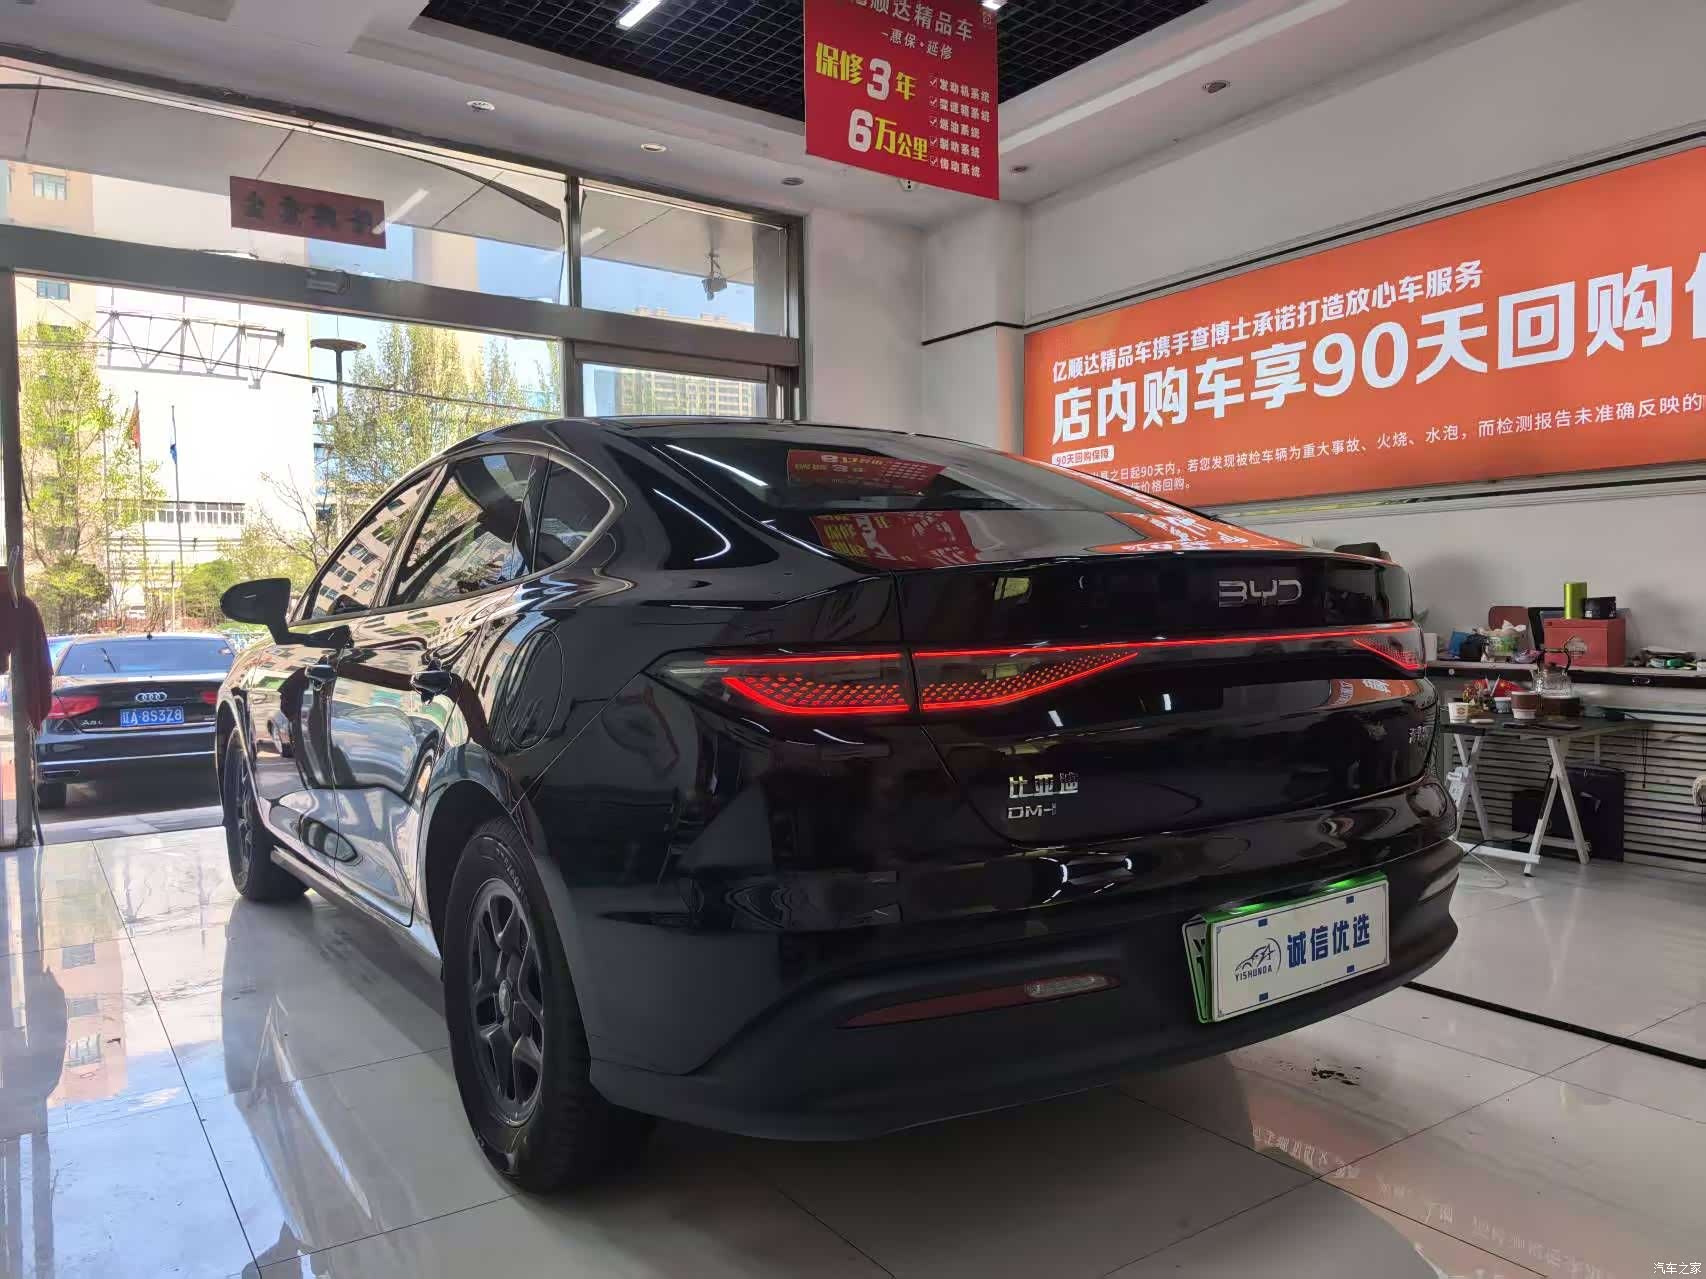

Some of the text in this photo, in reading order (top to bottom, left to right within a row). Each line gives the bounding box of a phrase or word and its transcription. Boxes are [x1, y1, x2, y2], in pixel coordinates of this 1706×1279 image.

[850, 0, 974, 41] 顺达精品车
[815, 42, 918, 101] 保修3年
[940, 79, 990, 103] 发动机系统
[848, 108, 928, 161] 6万公里
[940, 138, 980, 159] 制动系统
[1052, 259, 1484, 380] 亿顺达精品车携手查博士承诺打造放心车服务
[1055, 447, 1110, 465] 90天回购保障
[1218, 579, 1303, 608] BYD
[1008, 771, 1079, 799] 比亚迪
[1287, 914, 1370, 968] 诚信优选
[1235, 963, 1273, 982] YISHUNDA
